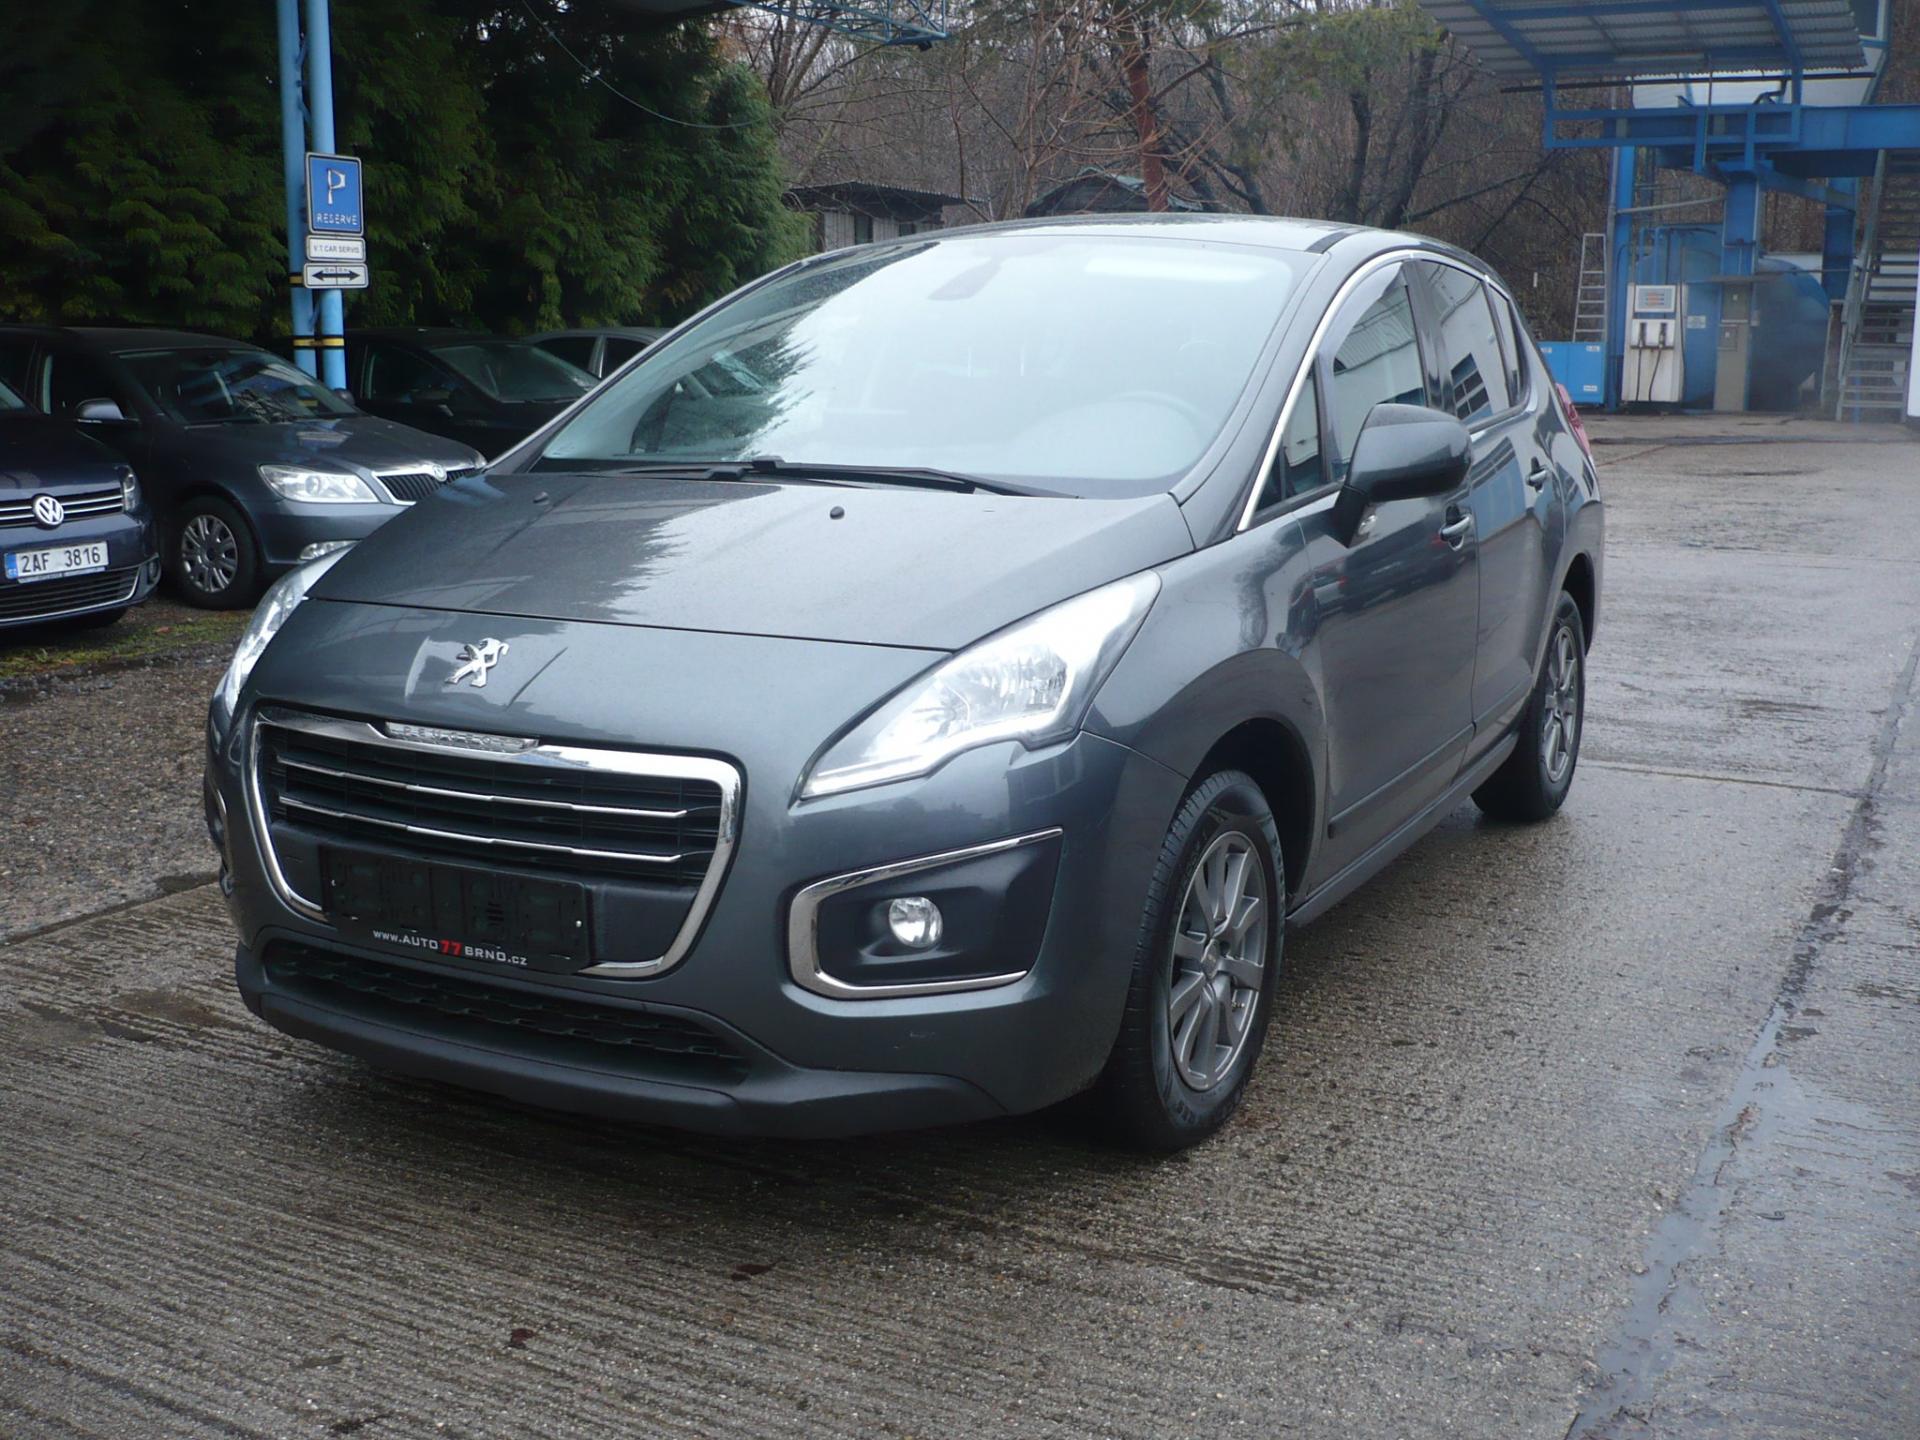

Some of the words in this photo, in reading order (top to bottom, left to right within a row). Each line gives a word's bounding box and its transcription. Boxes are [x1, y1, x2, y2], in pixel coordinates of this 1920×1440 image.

[327, 168, 346, 205] P
[316, 212, 358, 226] RESERVE
[21, 552, 51, 573] 2AF
[64, 546, 101, 568] 3816
